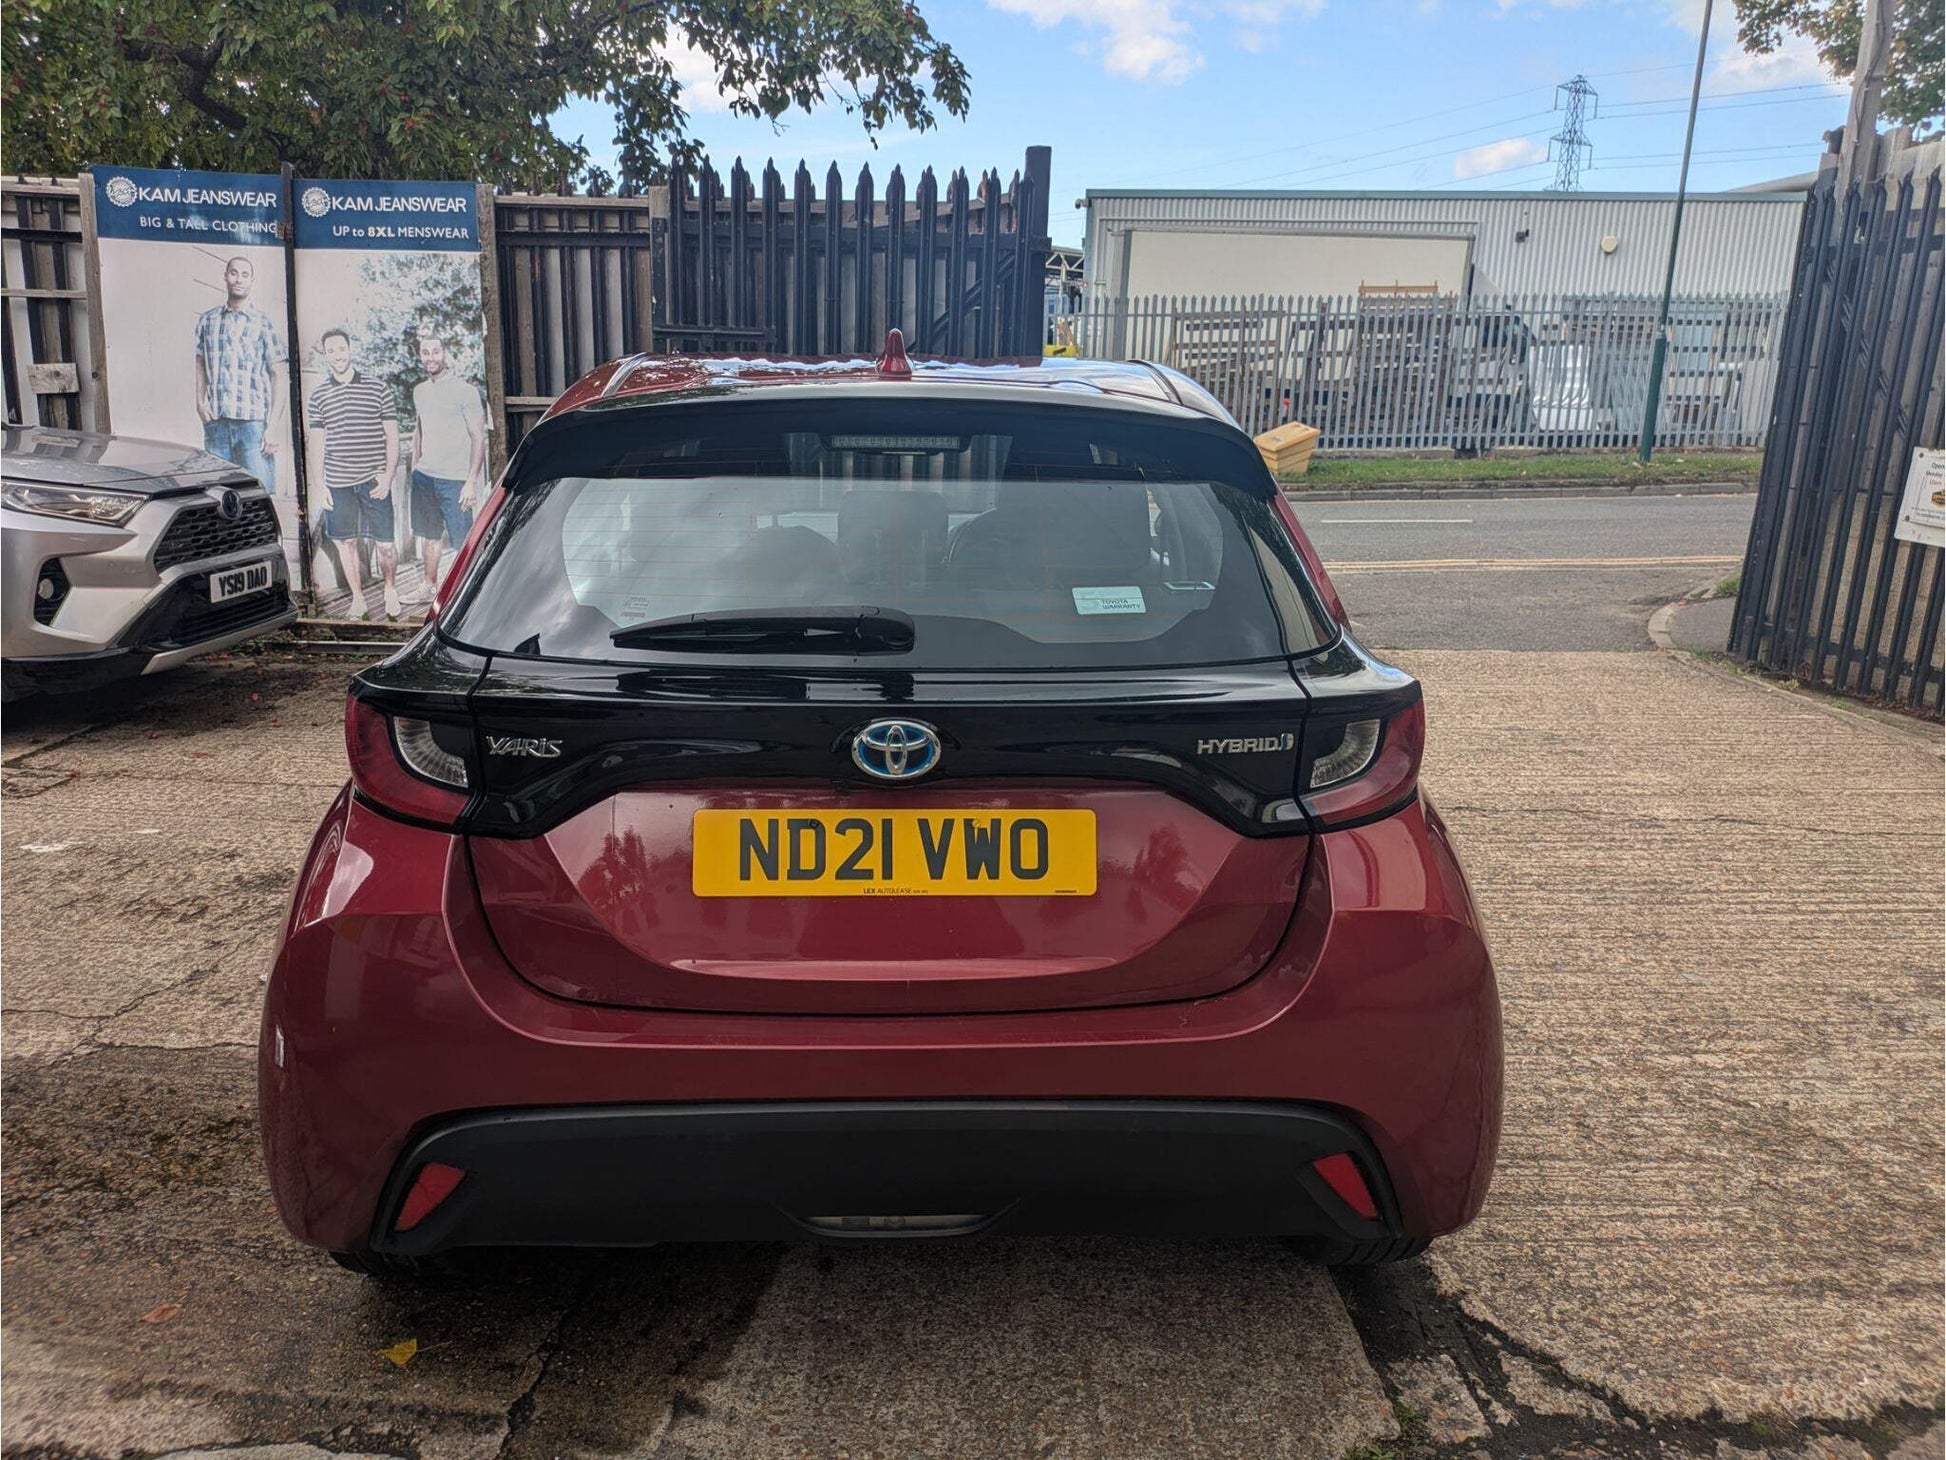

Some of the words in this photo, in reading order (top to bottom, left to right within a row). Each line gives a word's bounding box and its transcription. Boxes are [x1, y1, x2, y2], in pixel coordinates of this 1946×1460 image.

[138, 187, 181, 203] KAM
[182, 188, 277, 208] JEANSWEAR
[332, 196, 373, 212] KAM
[375, 197, 467, 213] JEANSWEAR
[139, 216, 161, 229] BIG
[166, 217, 175, 229] &
[178, 218, 208, 231] TALL
[212, 220, 277, 234] CLOTHING
[332, 225, 350, 237] UP
[352, 227, 365, 237] to
[367, 226, 395, 238] 8XL
[397, 226, 469, 239] MENSWEAR
[219, 571, 245, 597] YS19
[246, 566, 268, 590] DAO
[485, 736, 563, 758] YARIS
[1197, 737, 1280, 755] HYBRID
[738, 817, 894, 881] ND21
[916, 817, 1049, 881] VWO
[863, 887, 876, 895] LEX
[877, 887, 912, 895] AUTOLEASE
